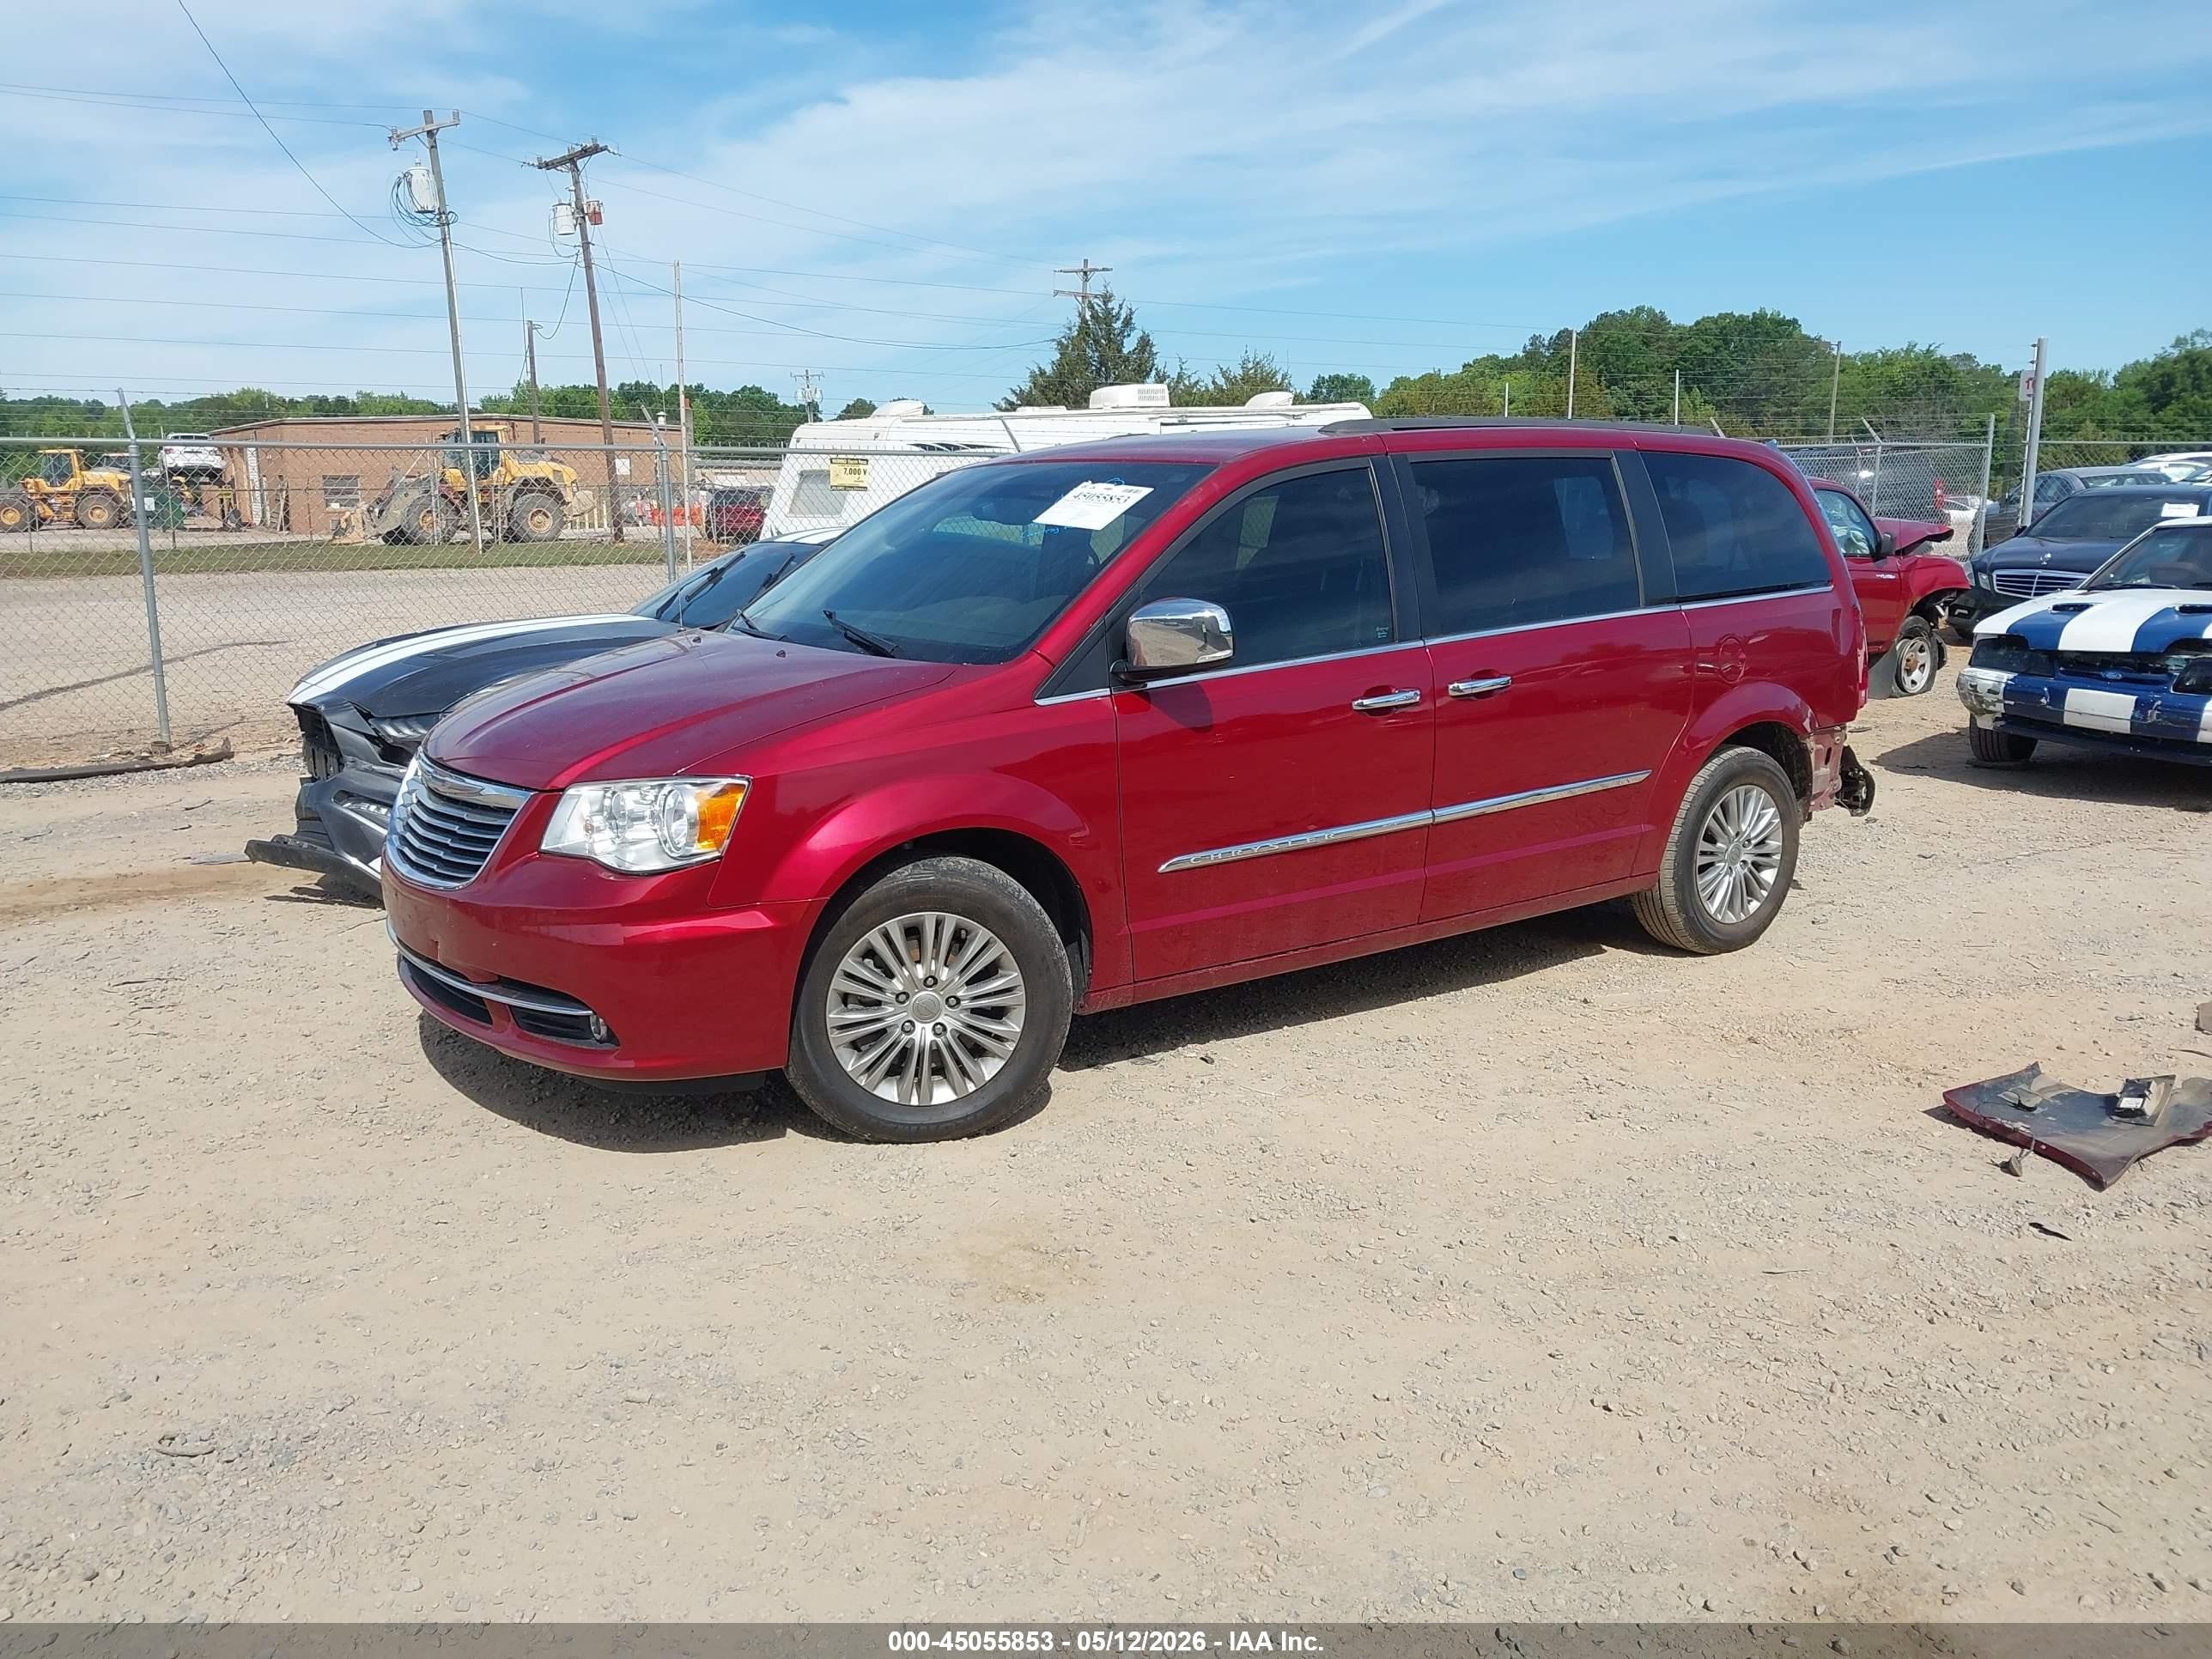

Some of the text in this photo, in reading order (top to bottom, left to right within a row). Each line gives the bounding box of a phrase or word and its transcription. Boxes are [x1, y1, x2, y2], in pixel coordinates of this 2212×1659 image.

[843, 467, 861, 476] 7,000
[1073, 491, 1131, 505] 45055853
[1190, 833, 1335, 865] CHRYSLER
